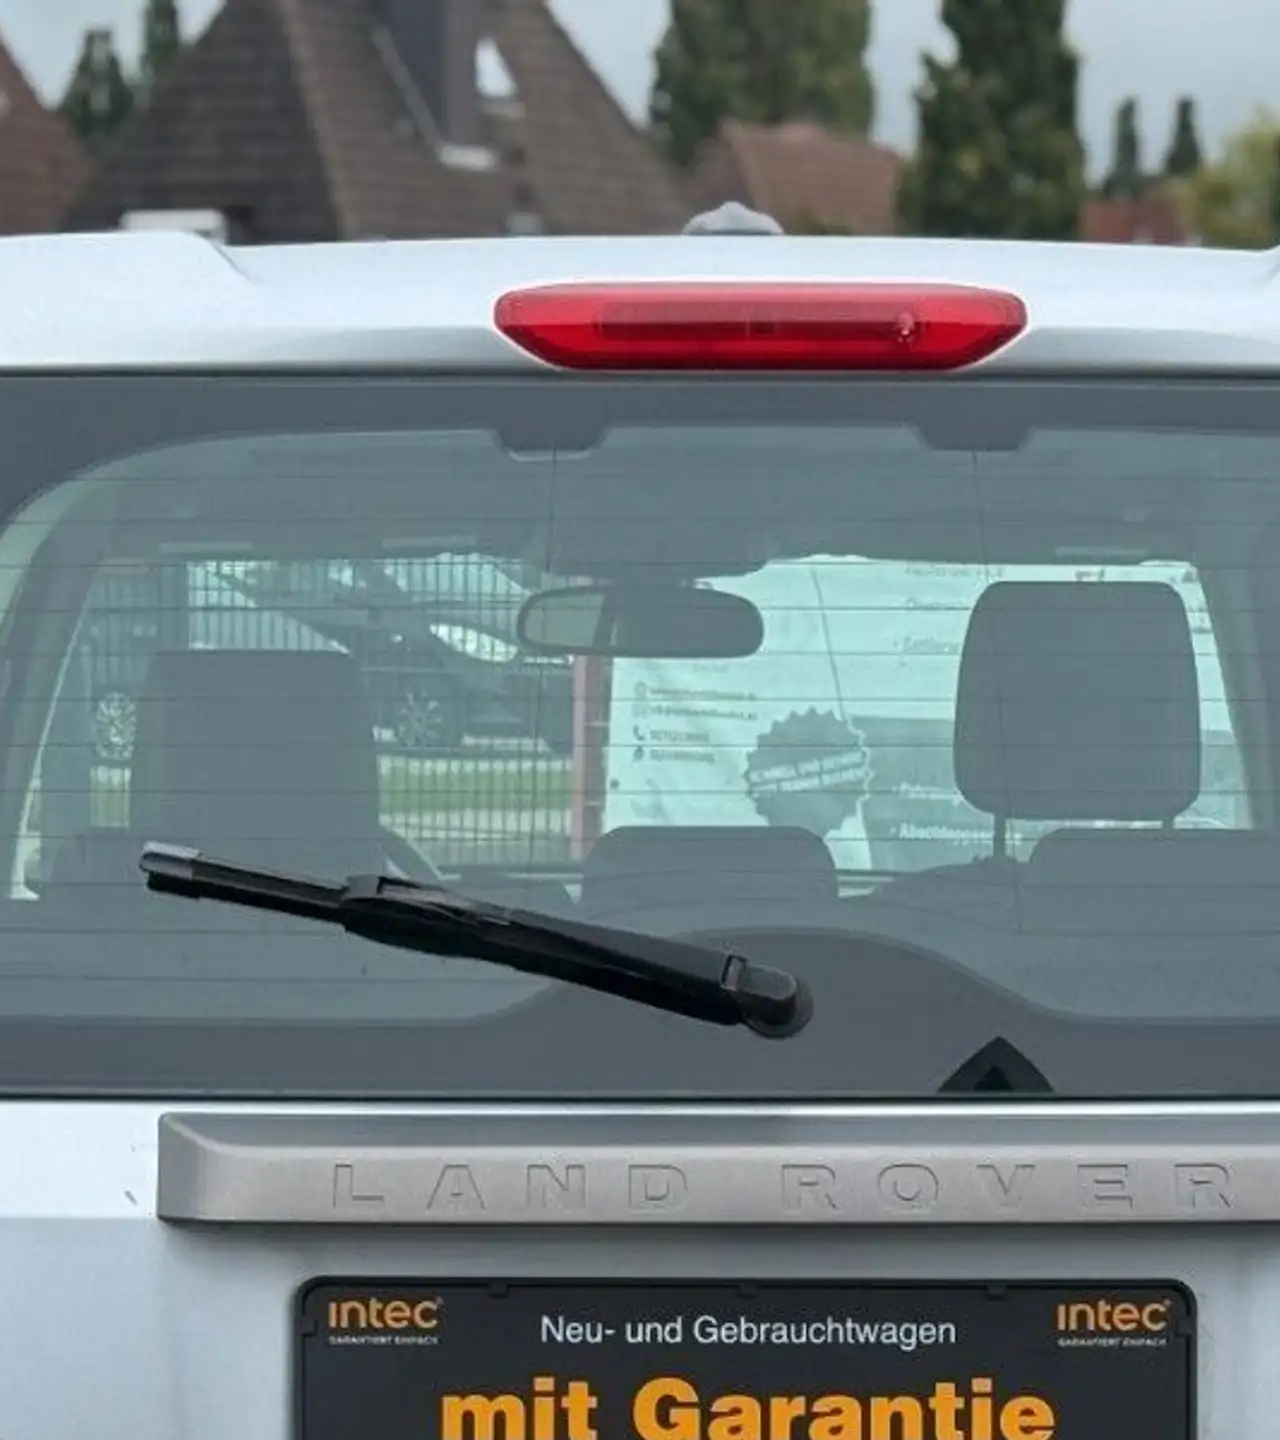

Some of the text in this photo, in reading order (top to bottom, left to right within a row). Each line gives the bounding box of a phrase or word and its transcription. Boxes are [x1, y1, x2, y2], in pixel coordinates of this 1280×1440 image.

[332, 1163, 1233, 1210] LAND ROVER
[328, 1297, 440, 1329] intec
[1057, 1300, 1168, 1331] intec
[540, 1315, 957, 1350] Neu- und Gebrauchtwagen
